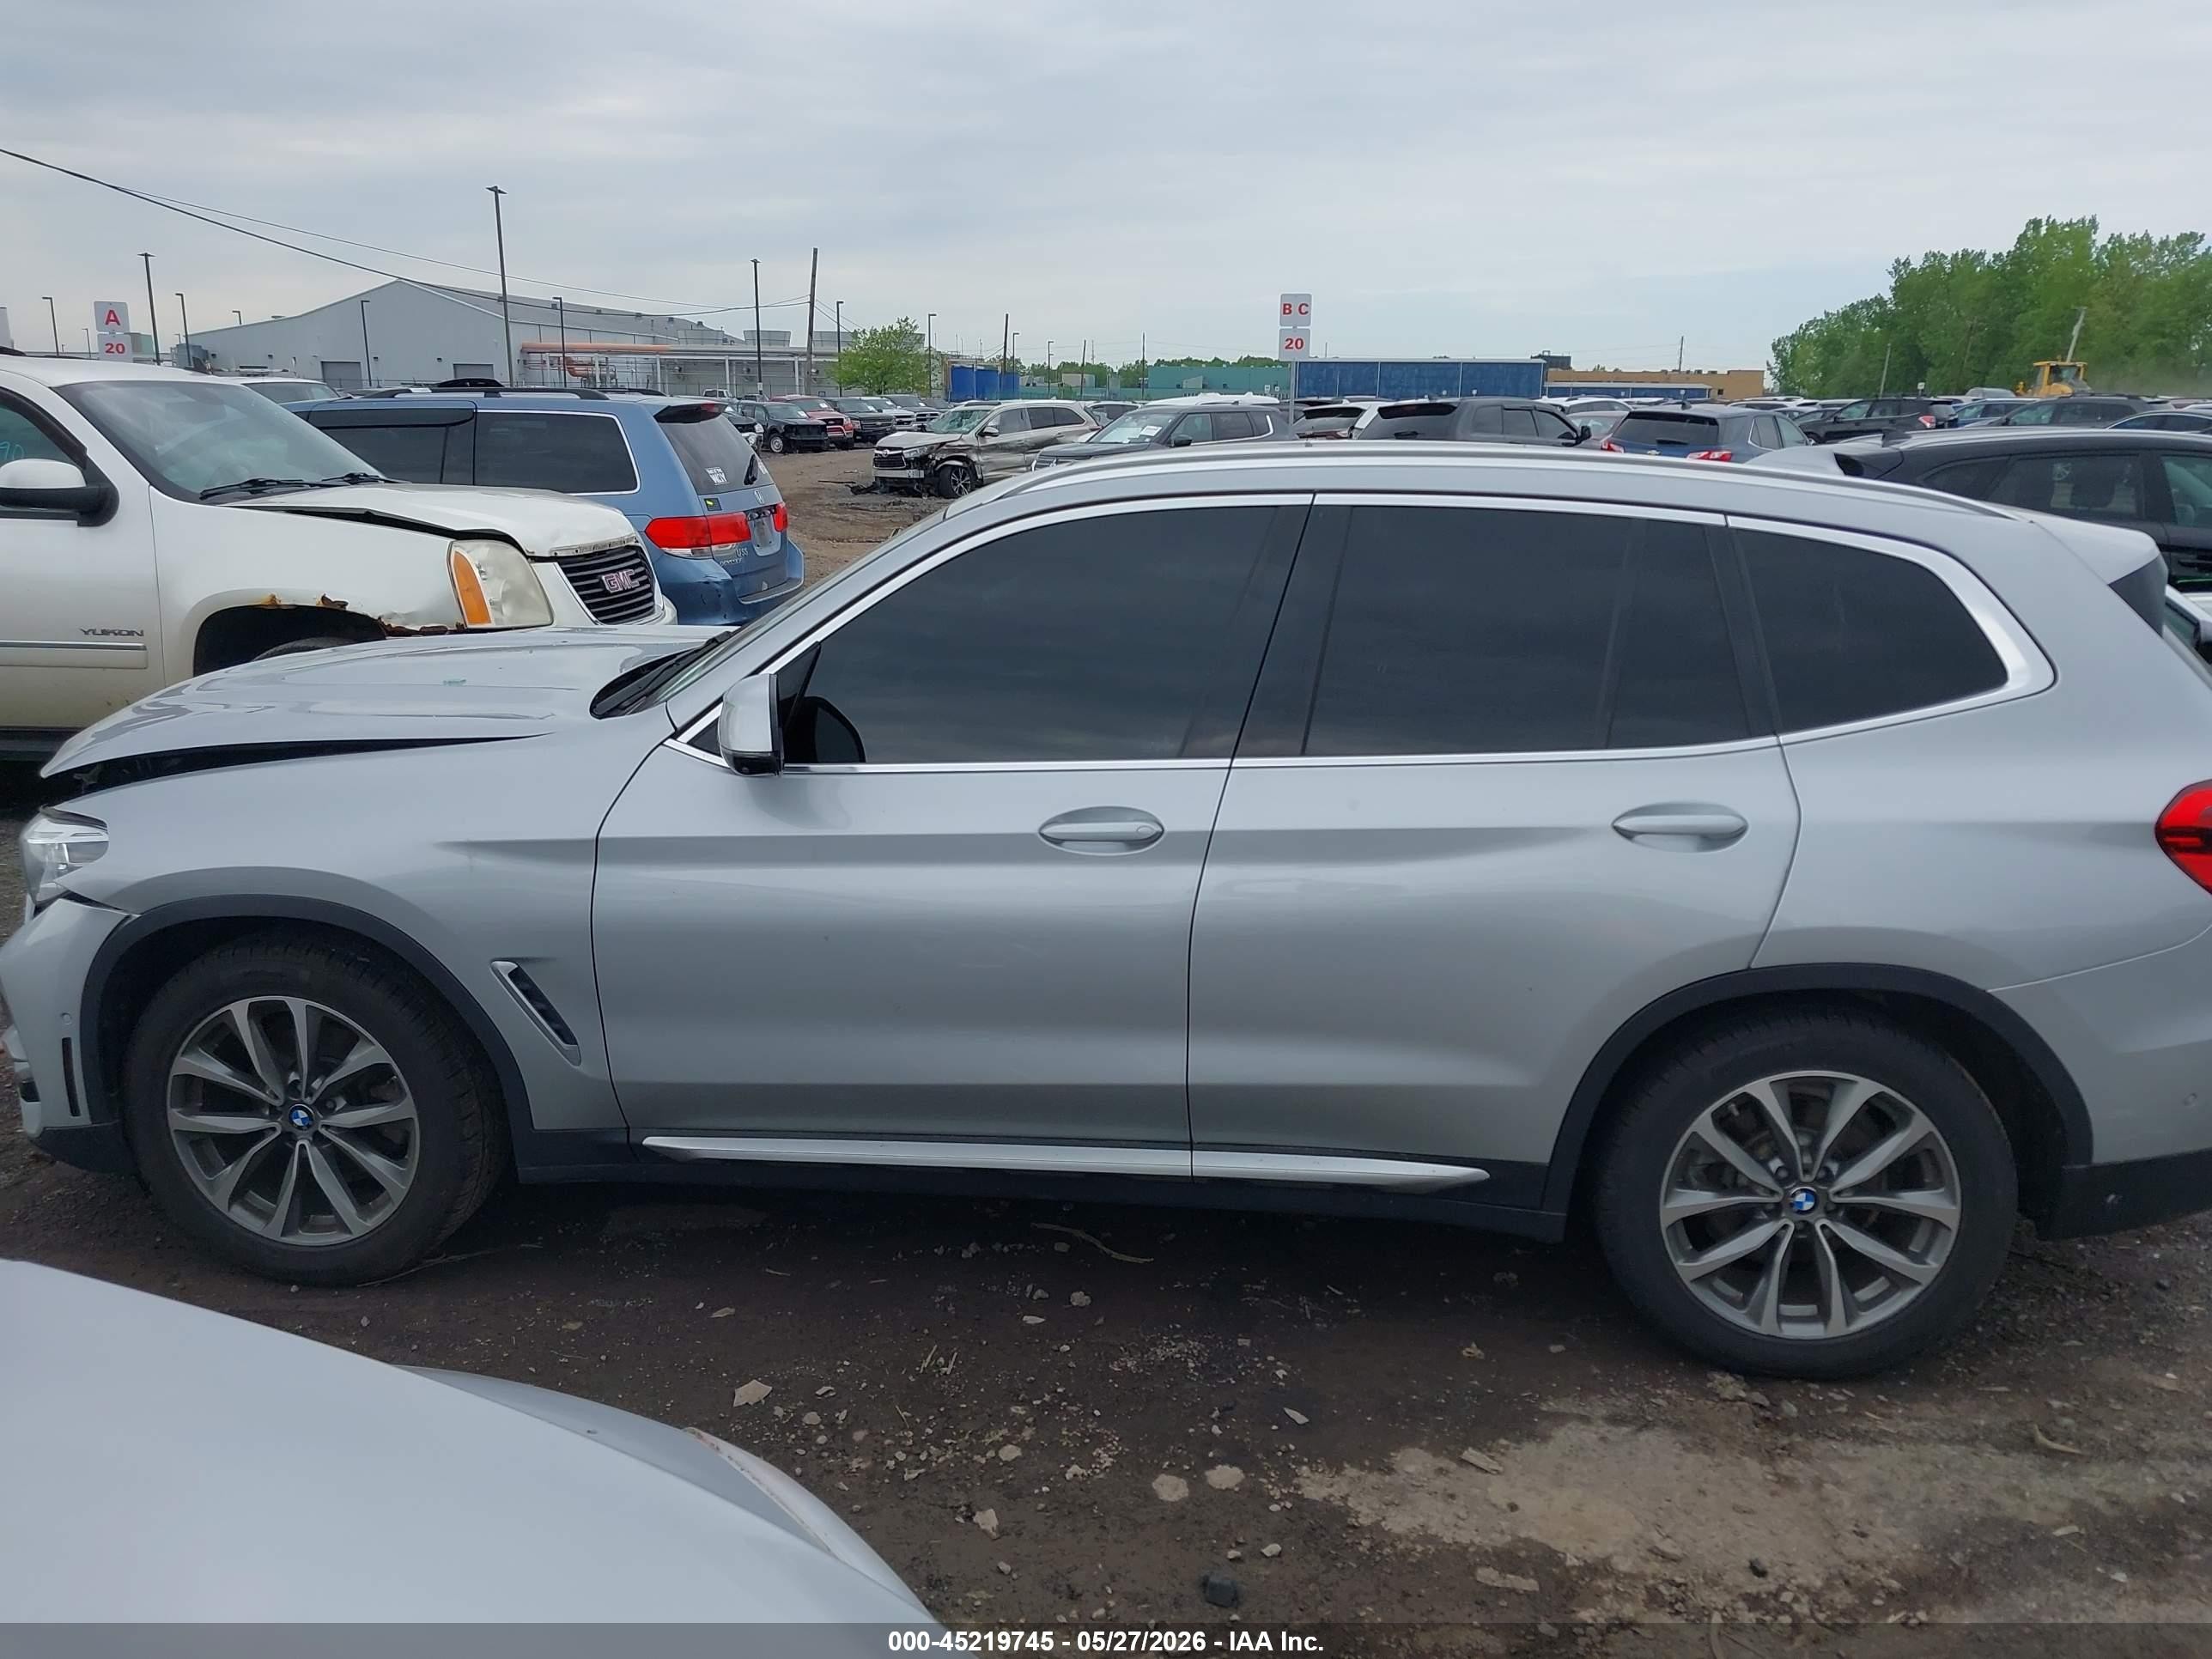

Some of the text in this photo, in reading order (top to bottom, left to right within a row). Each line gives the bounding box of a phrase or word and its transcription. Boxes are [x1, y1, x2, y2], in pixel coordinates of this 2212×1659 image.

[1282, 302, 1310, 316] B C
[105, 309, 121, 326] A
[104, 343, 126, 355] 20
[1284, 337, 1304, 350] 20
[601, 568, 641, 594] GMC
[79, 628, 144, 637] YUKON
